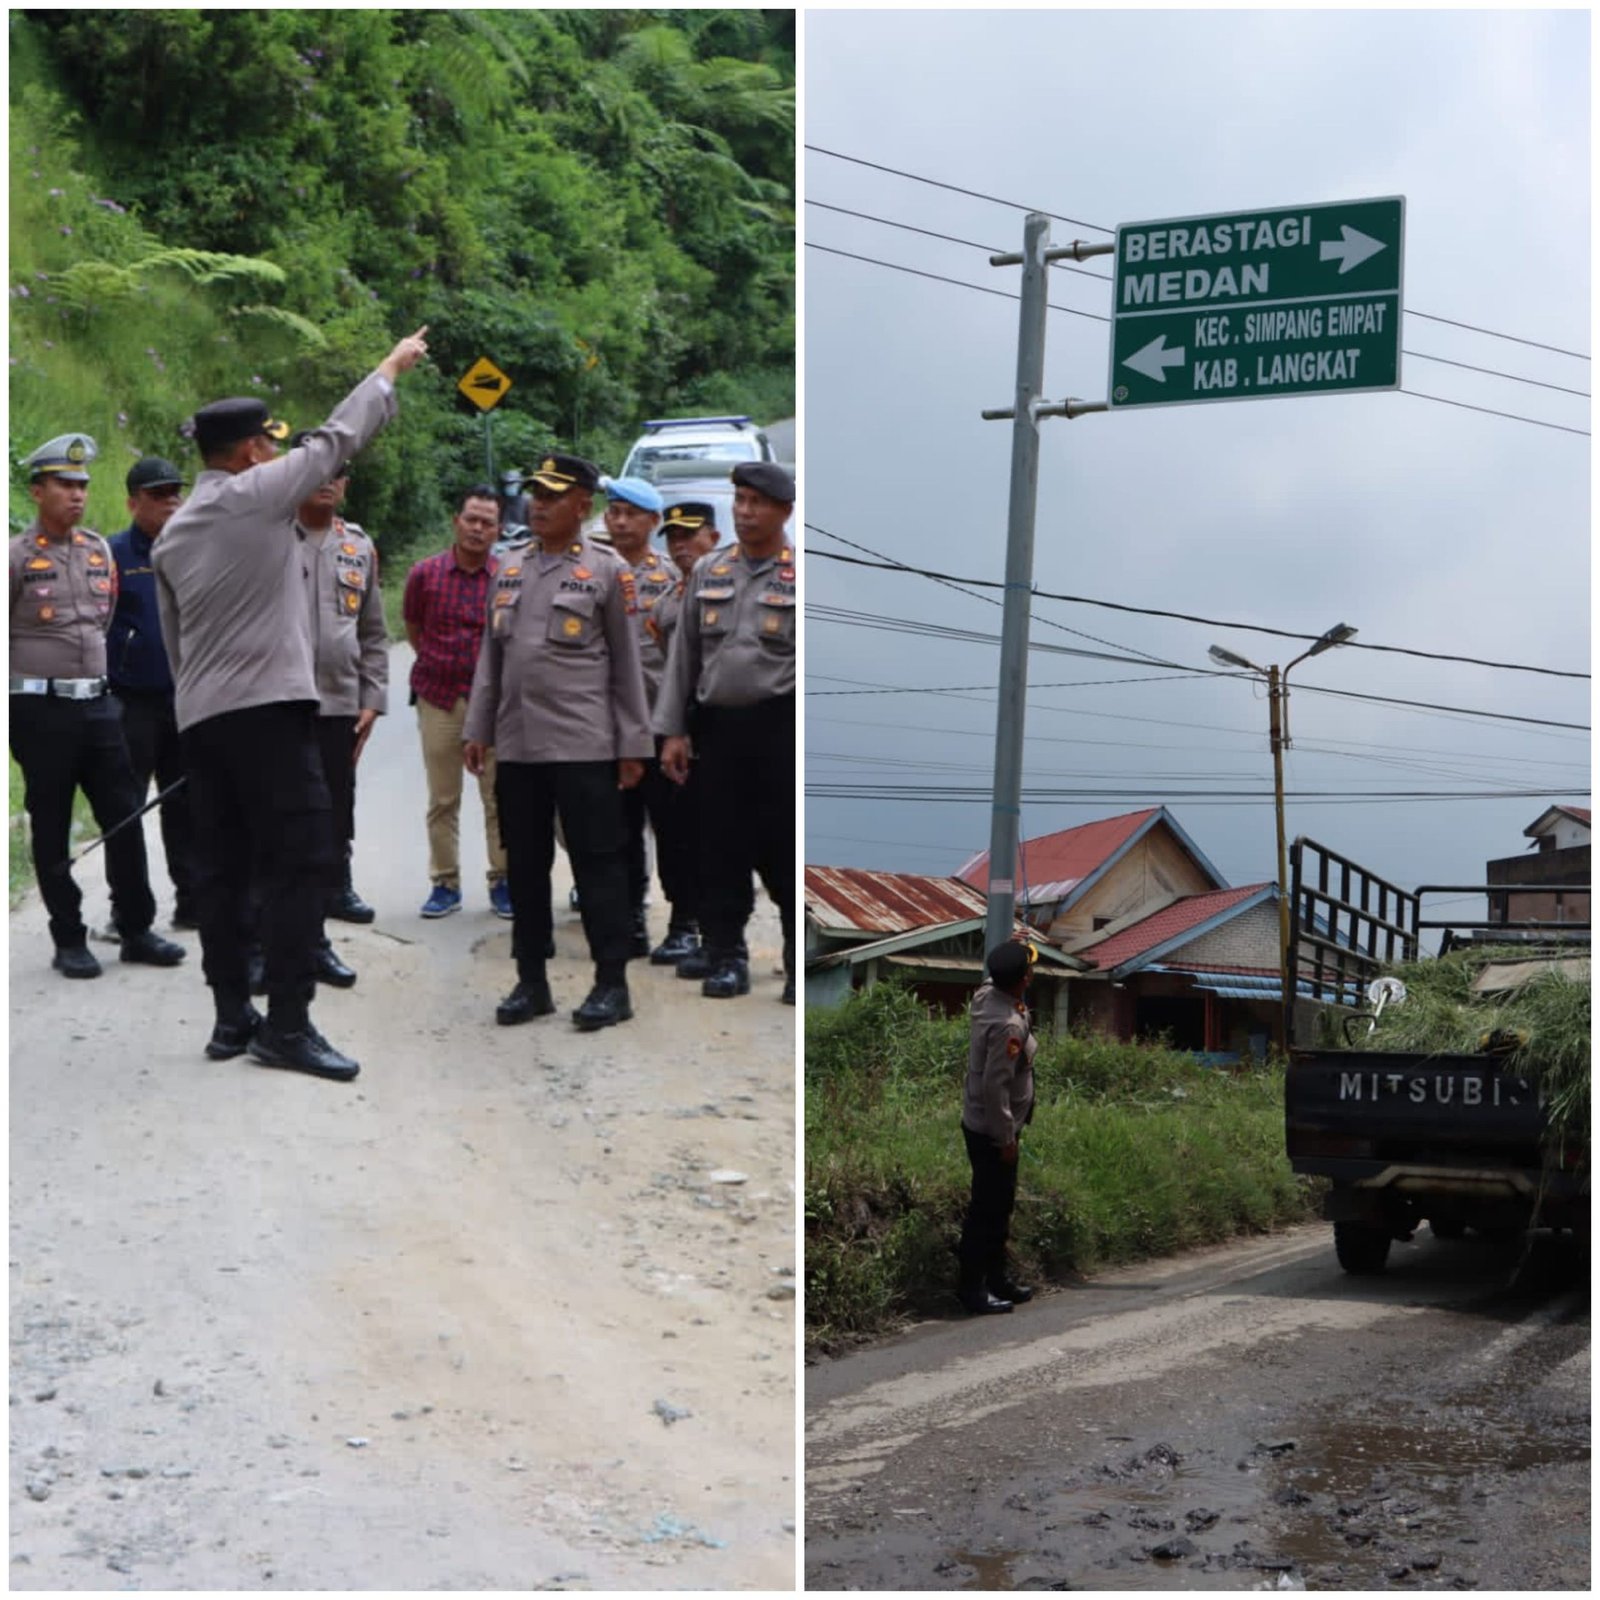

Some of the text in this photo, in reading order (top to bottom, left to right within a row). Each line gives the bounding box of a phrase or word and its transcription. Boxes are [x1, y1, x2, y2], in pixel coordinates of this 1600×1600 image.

[1125, 217, 1311, 263] BERASTAGI
[1123, 263, 1269, 305] MEDAN
[1245, 309, 1322, 344] SIMPANG
[1328, 303, 1387, 336] EMPAT
[1256, 349, 1361, 386] LANGKAT
